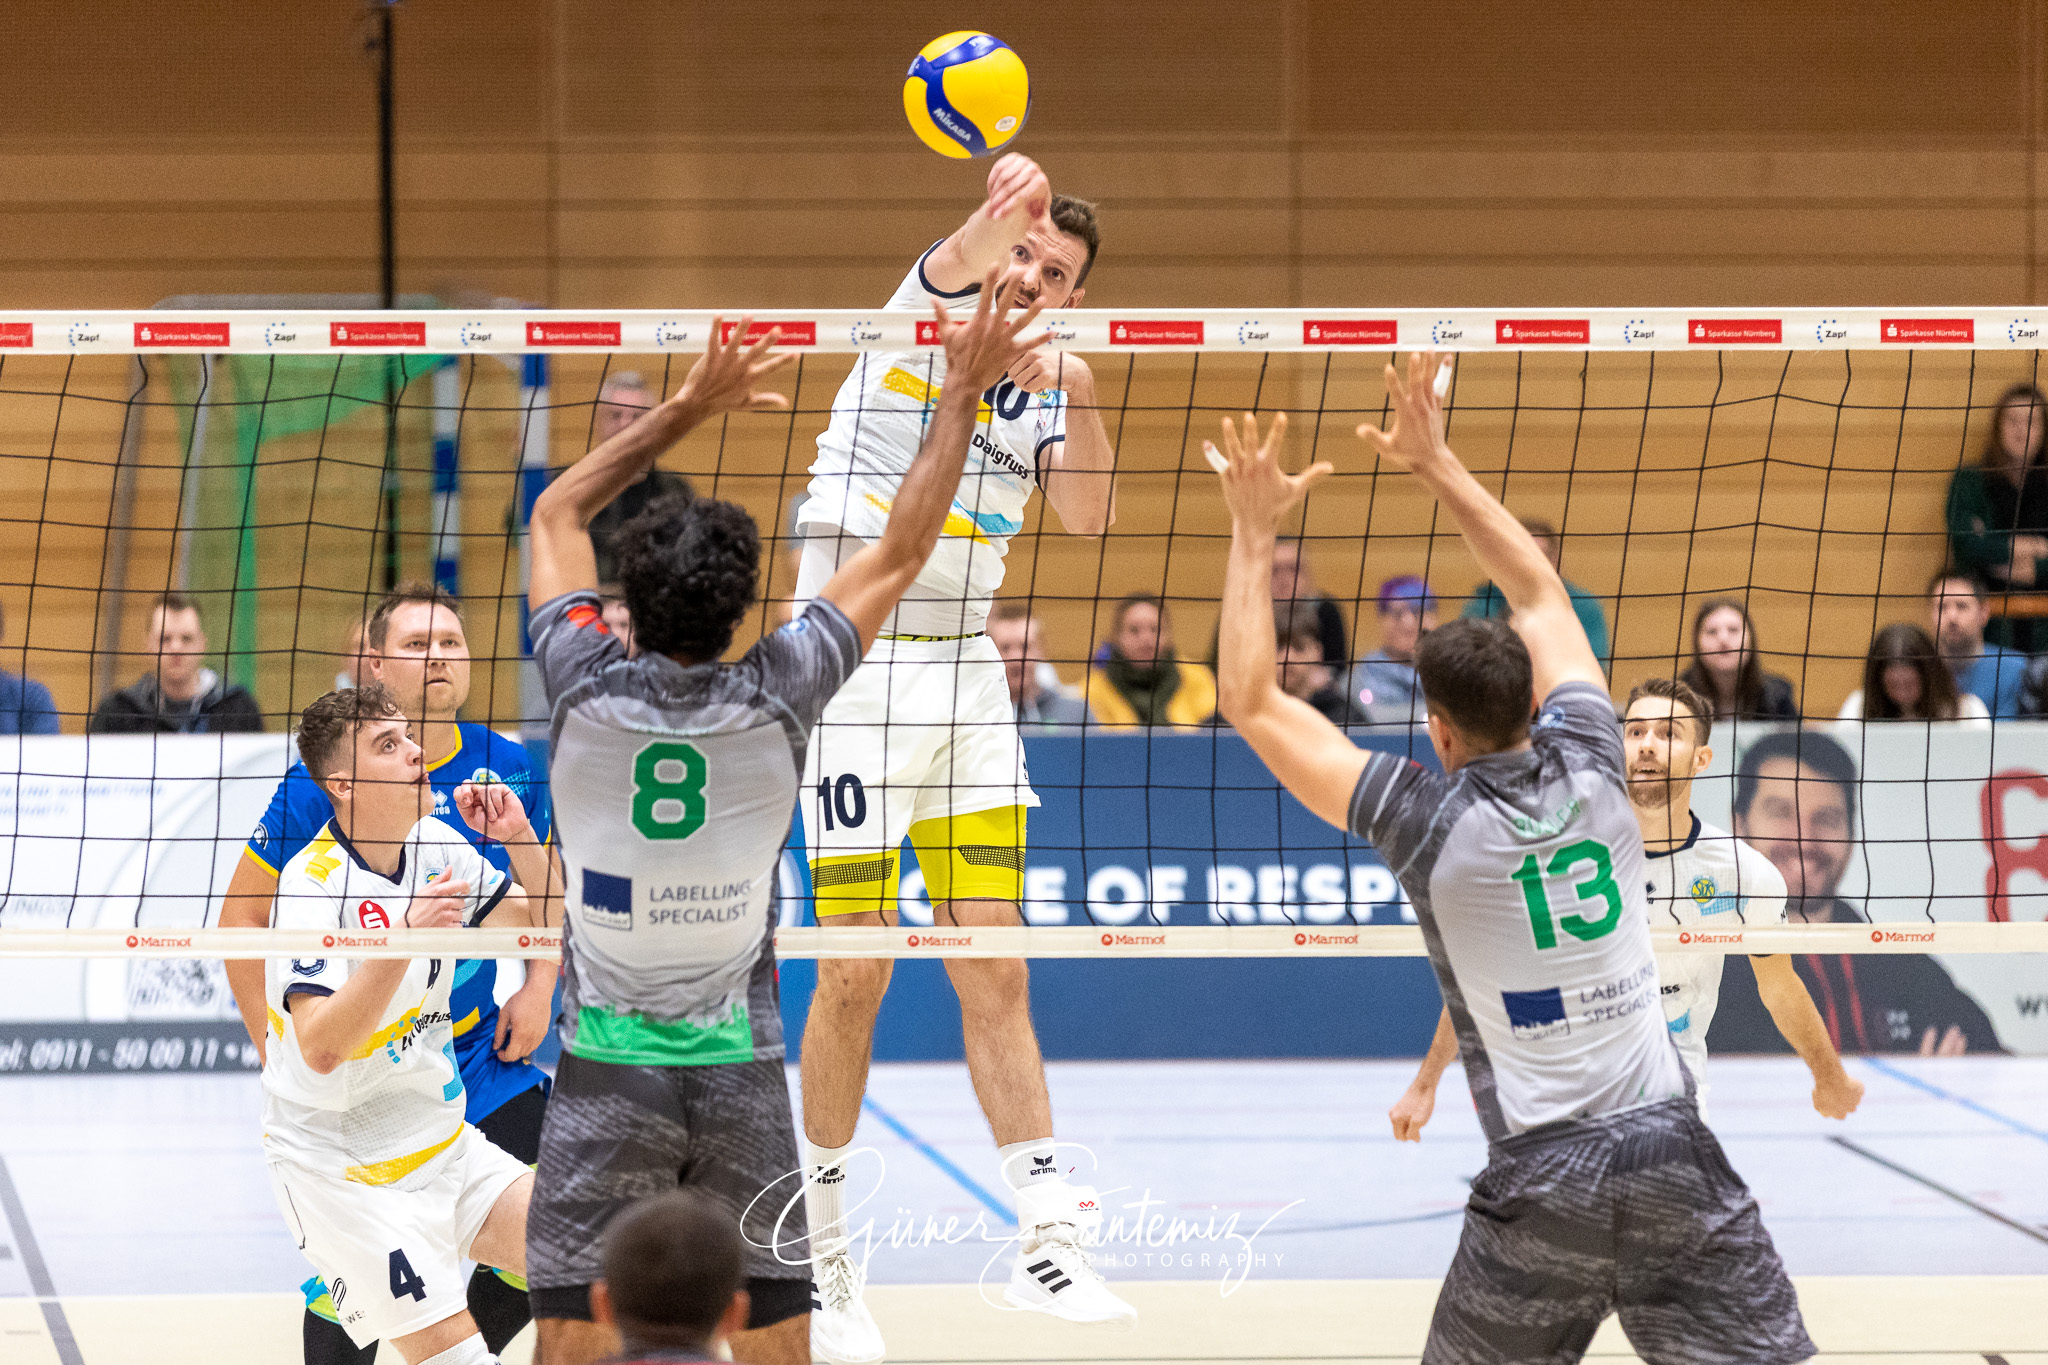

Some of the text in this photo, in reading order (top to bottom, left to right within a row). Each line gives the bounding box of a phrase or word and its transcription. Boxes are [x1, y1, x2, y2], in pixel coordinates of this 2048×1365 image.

[78, 334, 99, 342] Zapf
[154, 332, 223, 341] Sparkasse Nürnberg
[274, 333, 296, 342] Zapf
[350, 331, 419, 340] Sparkasse Nürnberg
[470, 333, 491, 342] Zapf
[546, 331, 615, 340] Sparkasse Nürnberg
[666, 333, 687, 341] Zapf
[861, 332, 881, 341] Zapf
[1129, 330, 1198, 339] Sparkasse Nürnberg
[1248, 332, 1269, 340] Zapf
[1323, 330, 1392, 339] Sparkasse Nürnberg
[1441, 331, 1462, 340] Zapf
[1515, 329, 1584, 338] Sparkasse Nürnberg
[1633, 330, 1654, 339] Zapf
[1708, 329, 1777, 338] Sparkasse Nürnberg
[1825, 330, 1846, 339] Zapf
[1900, 329, 1969, 338] Sparkasse Nürnberg
[2017, 329, 2039, 339] Zapf
[971, 434, 1030, 479] Daigfuss
[630, 740, 709, 841] 8
[817, 773, 867, 831] 10
[649, 879, 751, 903] LABELLING
[1087, 863, 1188, 925] OF
[1511, 838, 1624, 951] 13
[648, 901, 748, 925] SPECIALIST
[336, 936, 386, 947] Marmot
[921, 936, 971, 947] Marmot
[1115, 934, 1165, 945] Marmot
[1308, 934, 1358, 945] Marmot
[1693, 933, 1743, 944] Marmot
[1885, 932, 1935, 943] Marmot
[140, 937, 190, 948] Marmot
[388, 1247, 427, 1303] 4
